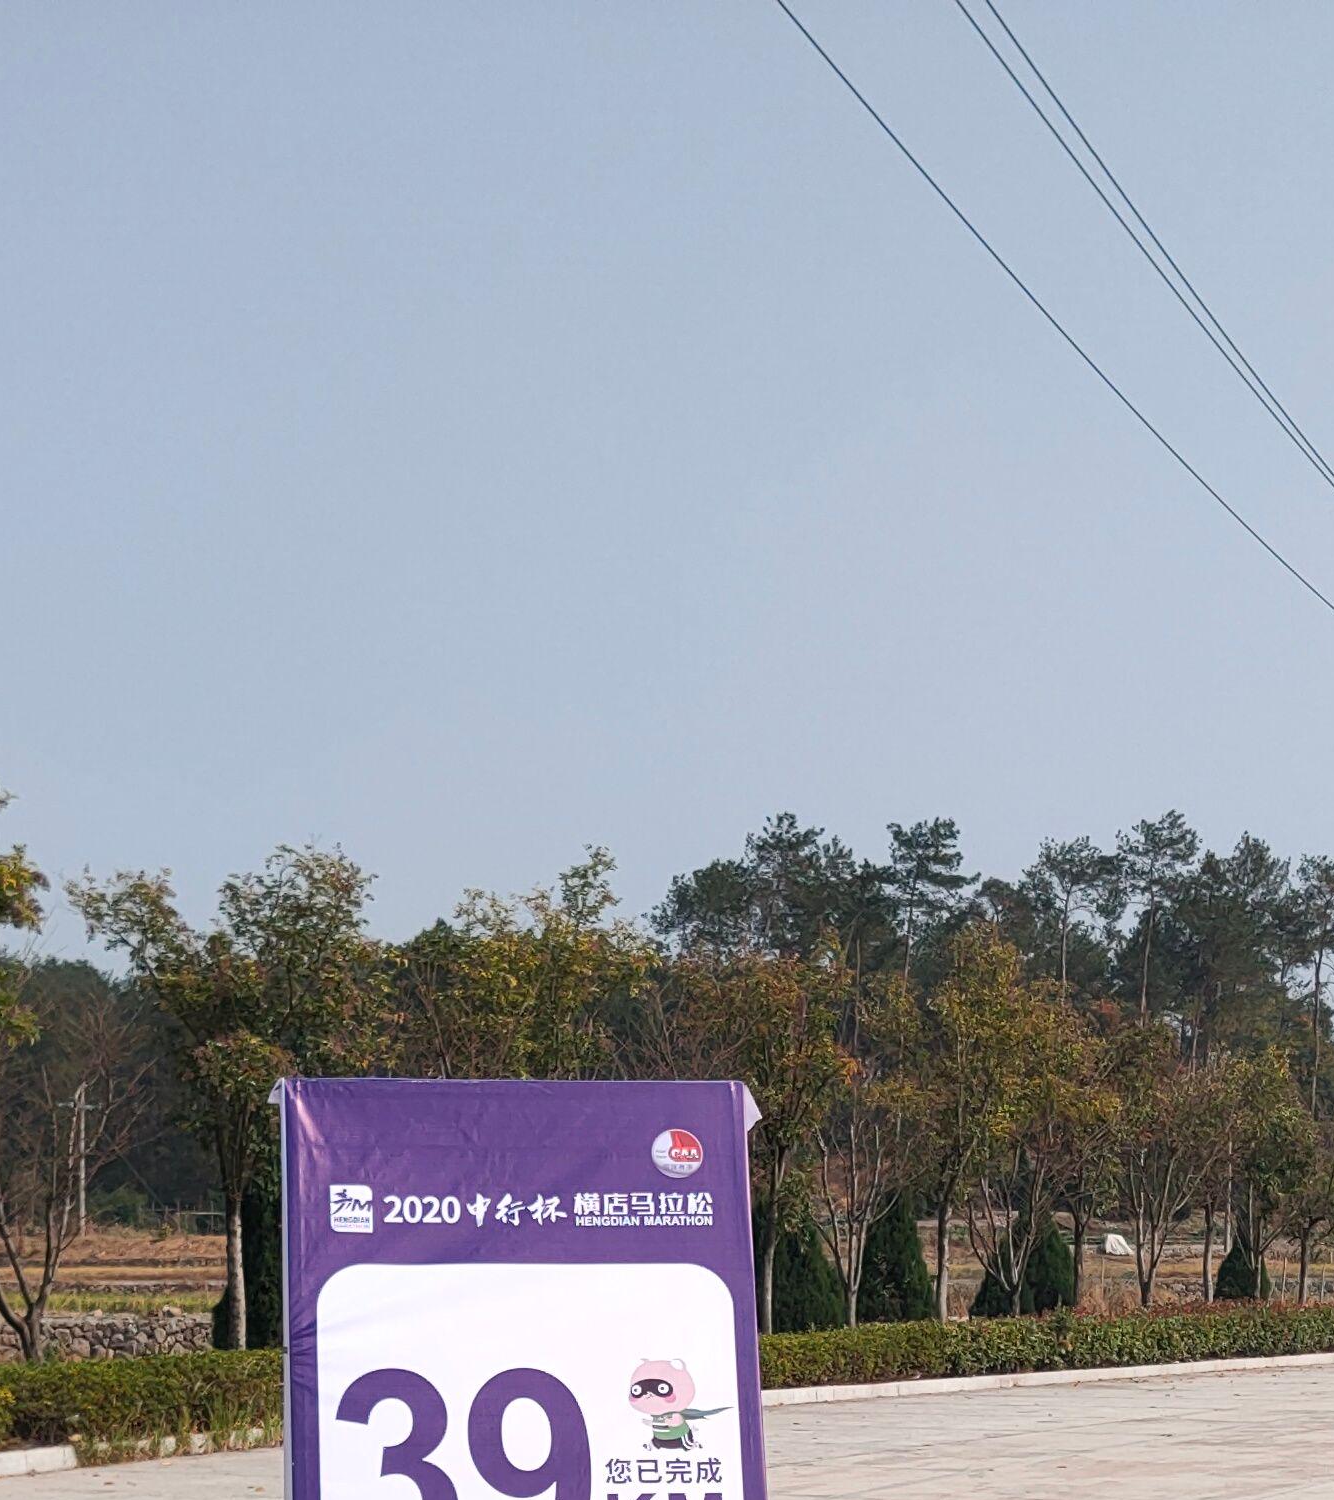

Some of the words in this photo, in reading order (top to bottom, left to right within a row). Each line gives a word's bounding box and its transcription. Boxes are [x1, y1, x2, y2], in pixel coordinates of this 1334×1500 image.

[383, 1195, 462, 1224] 2020
[466, 1192, 568, 1227] 中行杯
[573, 1192, 714, 1216] 横店马拉松
[575, 1215, 640, 1227] HENGDIAN
[644, 1215, 713, 1227] MARATHON
[604, 1457, 723, 1486] 您已完成
